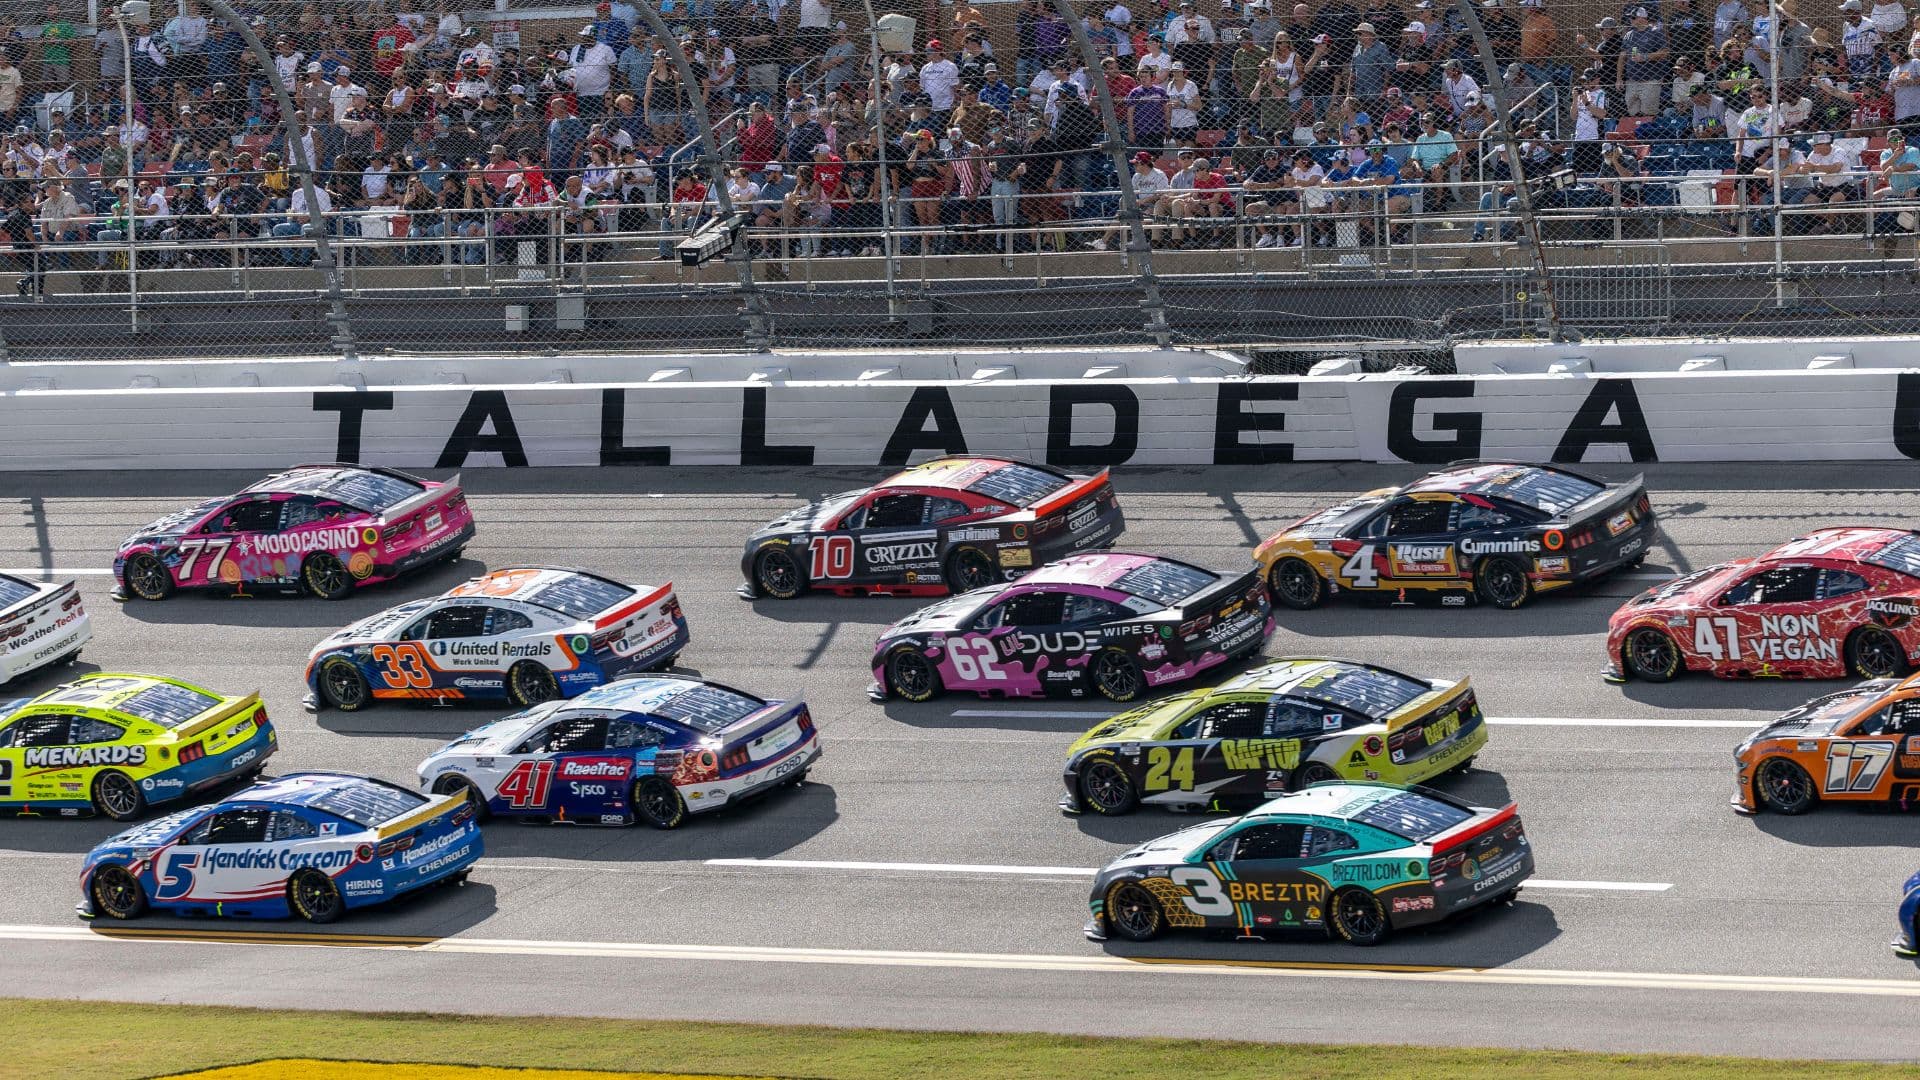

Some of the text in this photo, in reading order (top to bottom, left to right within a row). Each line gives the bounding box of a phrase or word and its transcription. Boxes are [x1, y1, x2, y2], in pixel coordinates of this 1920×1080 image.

[313, 379, 1658, 467] TALLADEGA
[1069, 509, 1097, 530] GRIZZLY
[420, 527, 463, 553] CHEVROLET
[1075, 525, 1110, 547] CHEVROLET
[1460, 537, 1540, 554] Cummins
[1619, 538, 1642, 557] FORD
[178, 538, 232, 580] 77
[808, 536, 854, 579] 10
[865, 542, 938, 564] GRIZZLY
[870, 564, 904, 572] NICOTINE
[1341, 545, 1378, 588] 4
[8, 612, 77, 650] WeatherTech
[1104, 625, 1155, 637] WIPES
[1220, 621, 1263, 650] CHEVROLET
[1760, 614, 1820, 637] NON
[34, 632, 79, 660] CHEVROLET
[451, 641, 551, 656] United Rentals
[633, 634, 676, 661] CHEVROLET
[1022, 630, 1102, 653] DUDE
[1694, 617, 1741, 660] 47
[1750, 638, 1838, 661] VEGAN
[372, 645, 433, 688] 33
[947, 637, 1008, 680] 62
[25, 745, 147, 768] MENARDS
[231, 749, 256, 769] FORD
[1221, 738, 1301, 769] RAPTOR
[1428, 732, 1476, 765] CHEVROLET
[564, 762, 625, 775] RaceTrac
[776, 756, 800, 776] FORD
[1145, 747, 1195, 791] 24
[1826, 741, 1894, 792] 17
[497, 761, 554, 808] 41
[570, 782, 606, 798] Sysco
[468, 821, 475, 832] 5
[1518, 836, 1526, 846] 3
[418, 845, 470, 875] CHEVROLET
[1333, 862, 1401, 881] BREZTRI.COM
[155, 853, 200, 899] 5
[345, 879, 383, 890] HIRING
[1474, 862, 1521, 892] CHEVROLET
[1170, 867, 1235, 916] 3
[1230, 882, 1325, 902] BREZTRI
